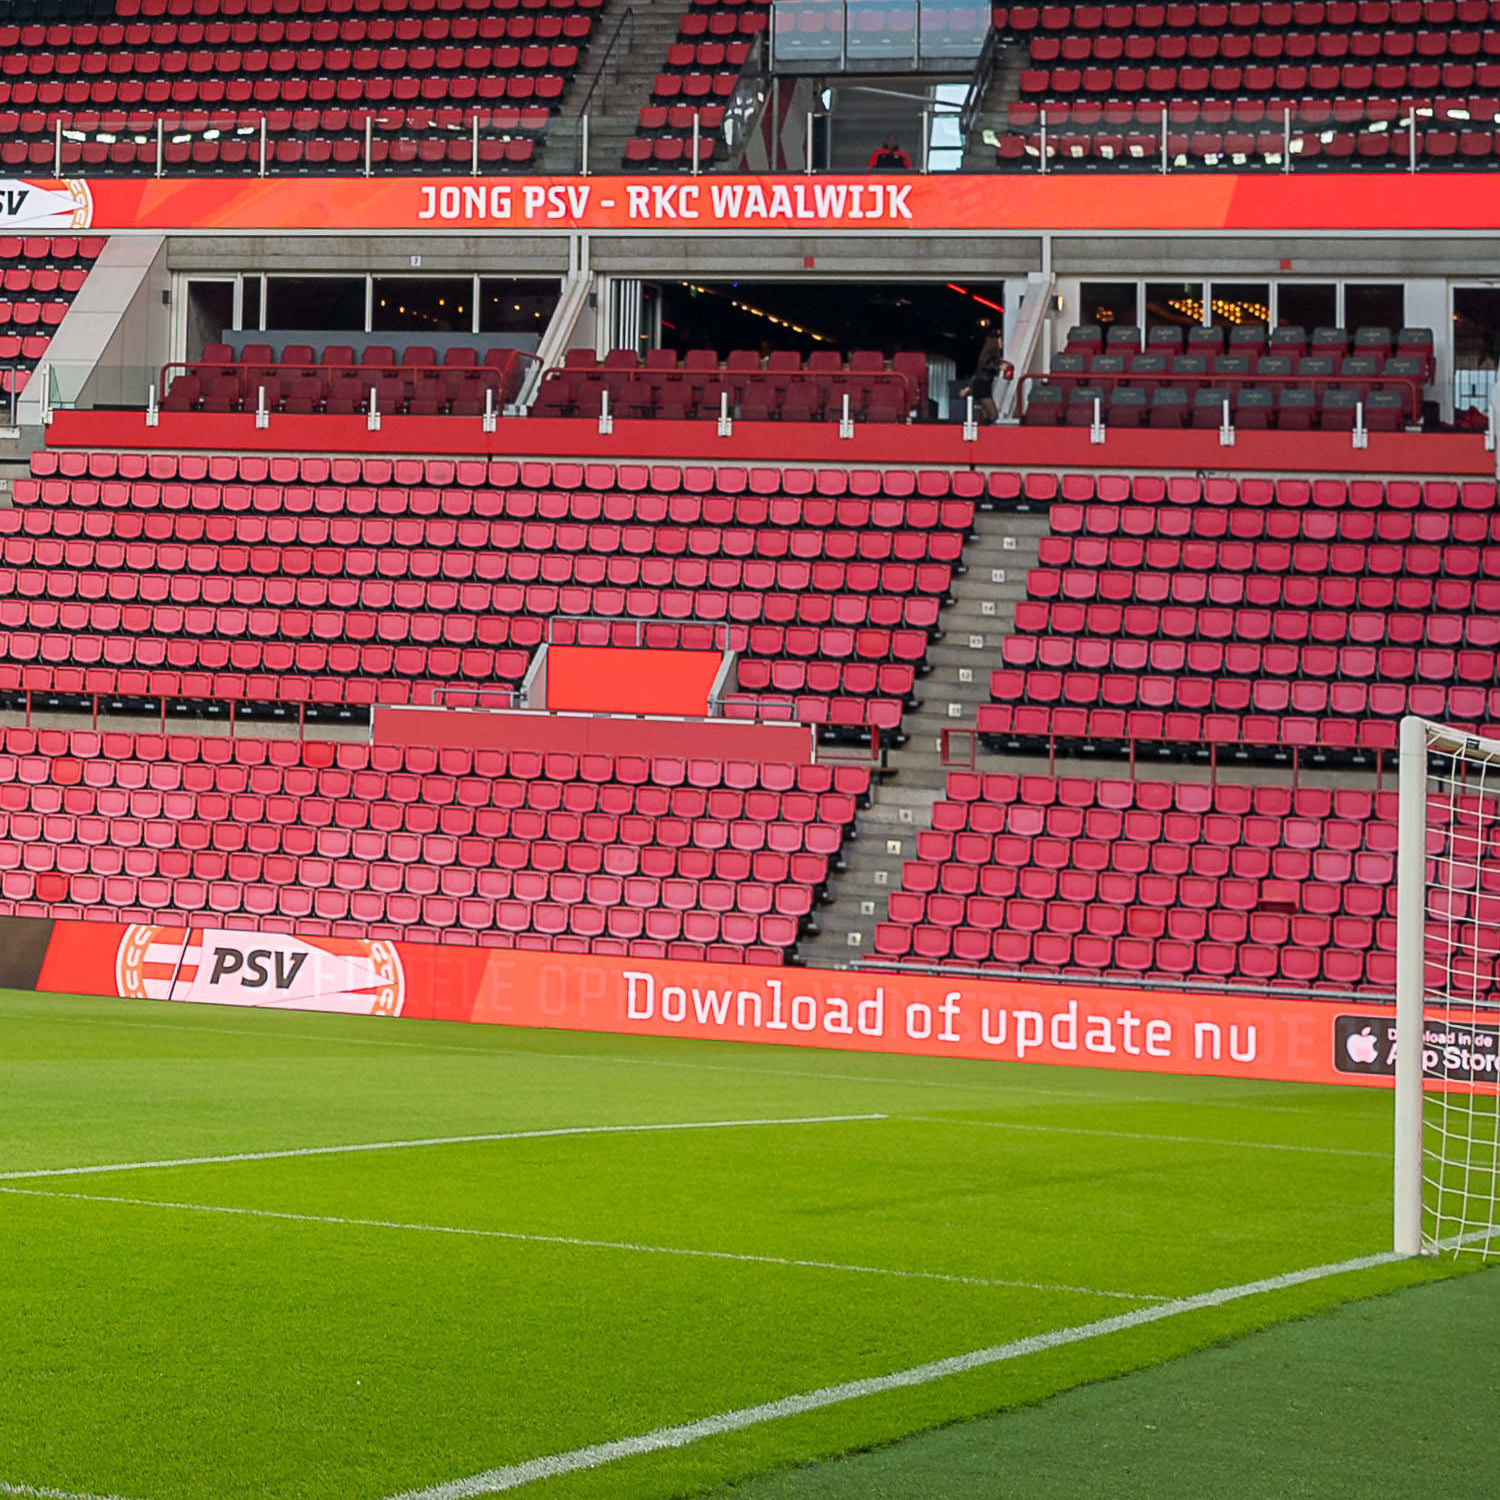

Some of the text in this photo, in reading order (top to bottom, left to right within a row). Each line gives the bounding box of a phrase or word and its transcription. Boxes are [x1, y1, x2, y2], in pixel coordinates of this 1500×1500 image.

[418, 186, 512, 221] JONG
[523, 186, 590, 220] PSV
[626, 186, 700, 220] RKC
[711, 186, 913, 220] WAALWIJK
[210, 947, 308, 990] PSV
[623, 971, 885, 1037] Download
[905, 992, 962, 1041] of
[980, 1001, 1172, 1057] update
[1195, 1022, 1258, 1062] nu
[1387, 1027, 1493, 1048] Dload in de
